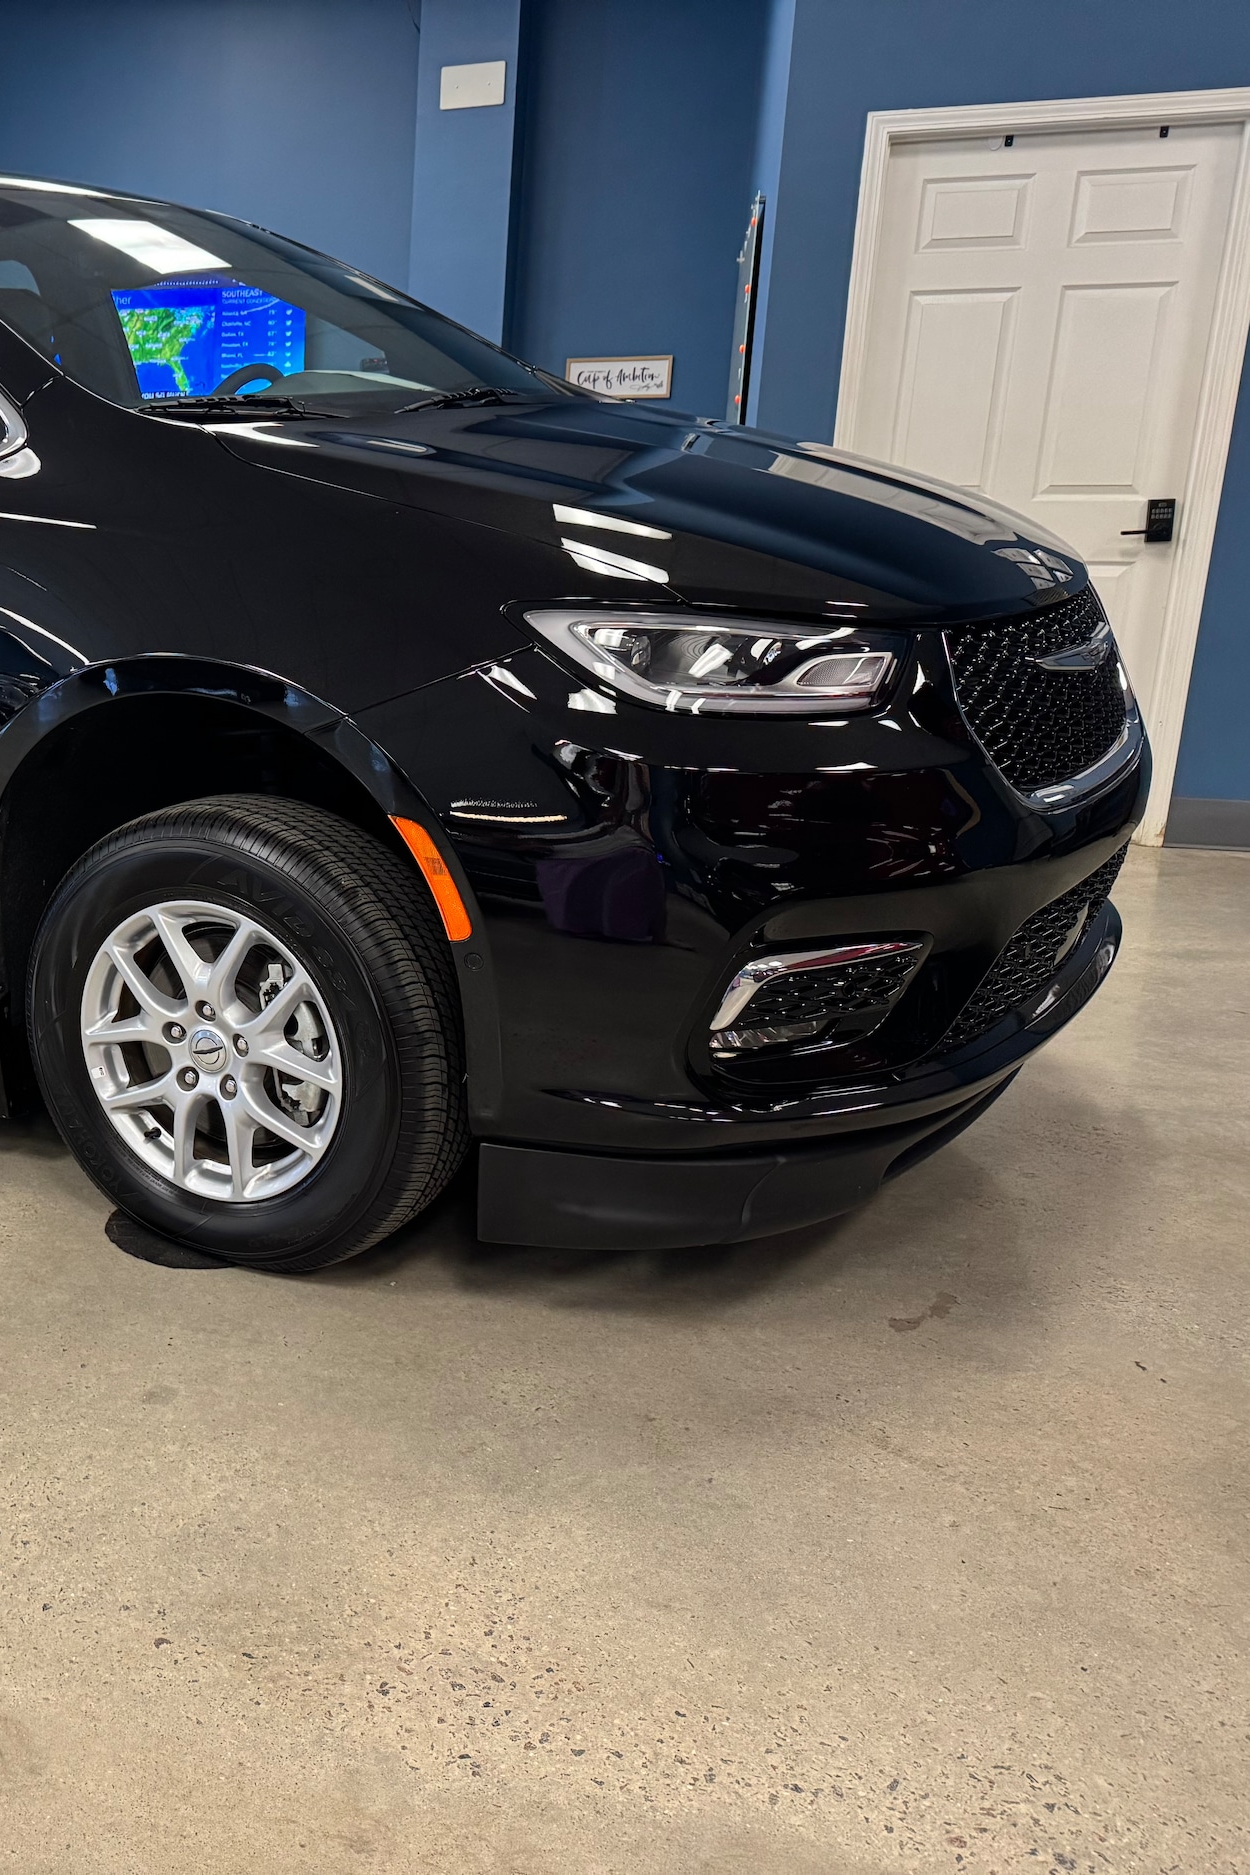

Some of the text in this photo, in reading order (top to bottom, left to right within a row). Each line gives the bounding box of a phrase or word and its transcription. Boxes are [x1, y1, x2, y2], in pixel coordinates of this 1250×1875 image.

[222, 288, 263, 298] SOUTHEAST
[577, 370, 600, 390] Cup
[602, 369, 613, 390] of
[615, 367, 660, 386] Ambition
